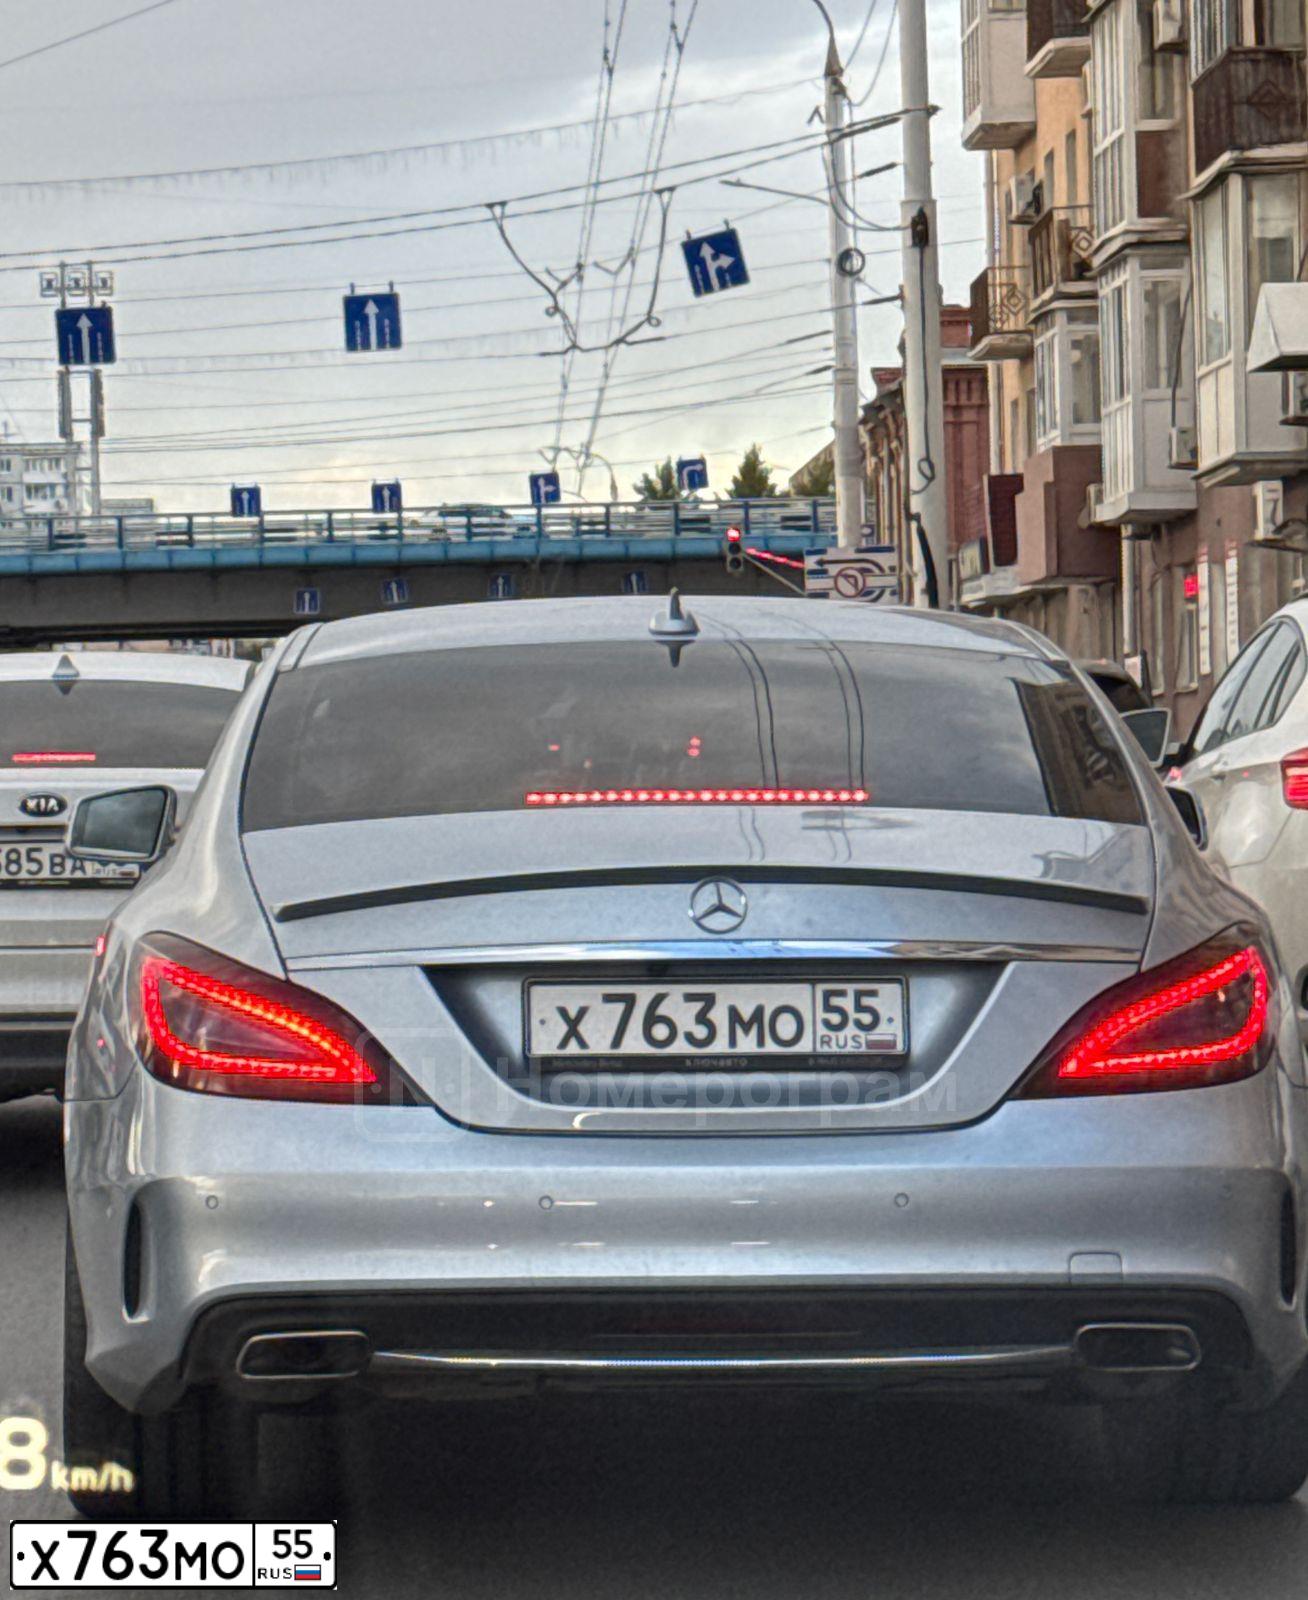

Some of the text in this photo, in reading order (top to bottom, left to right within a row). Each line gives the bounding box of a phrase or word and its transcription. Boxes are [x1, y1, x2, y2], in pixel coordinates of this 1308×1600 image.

[26, 797, 59, 813] KIA
[0, 847, 86, 876] 85ВА
[555, 989, 881, 1050] Х763МО 55
[820, 1034, 863, 1049] RUS
[51, 1460, 134, 1492] km/h
